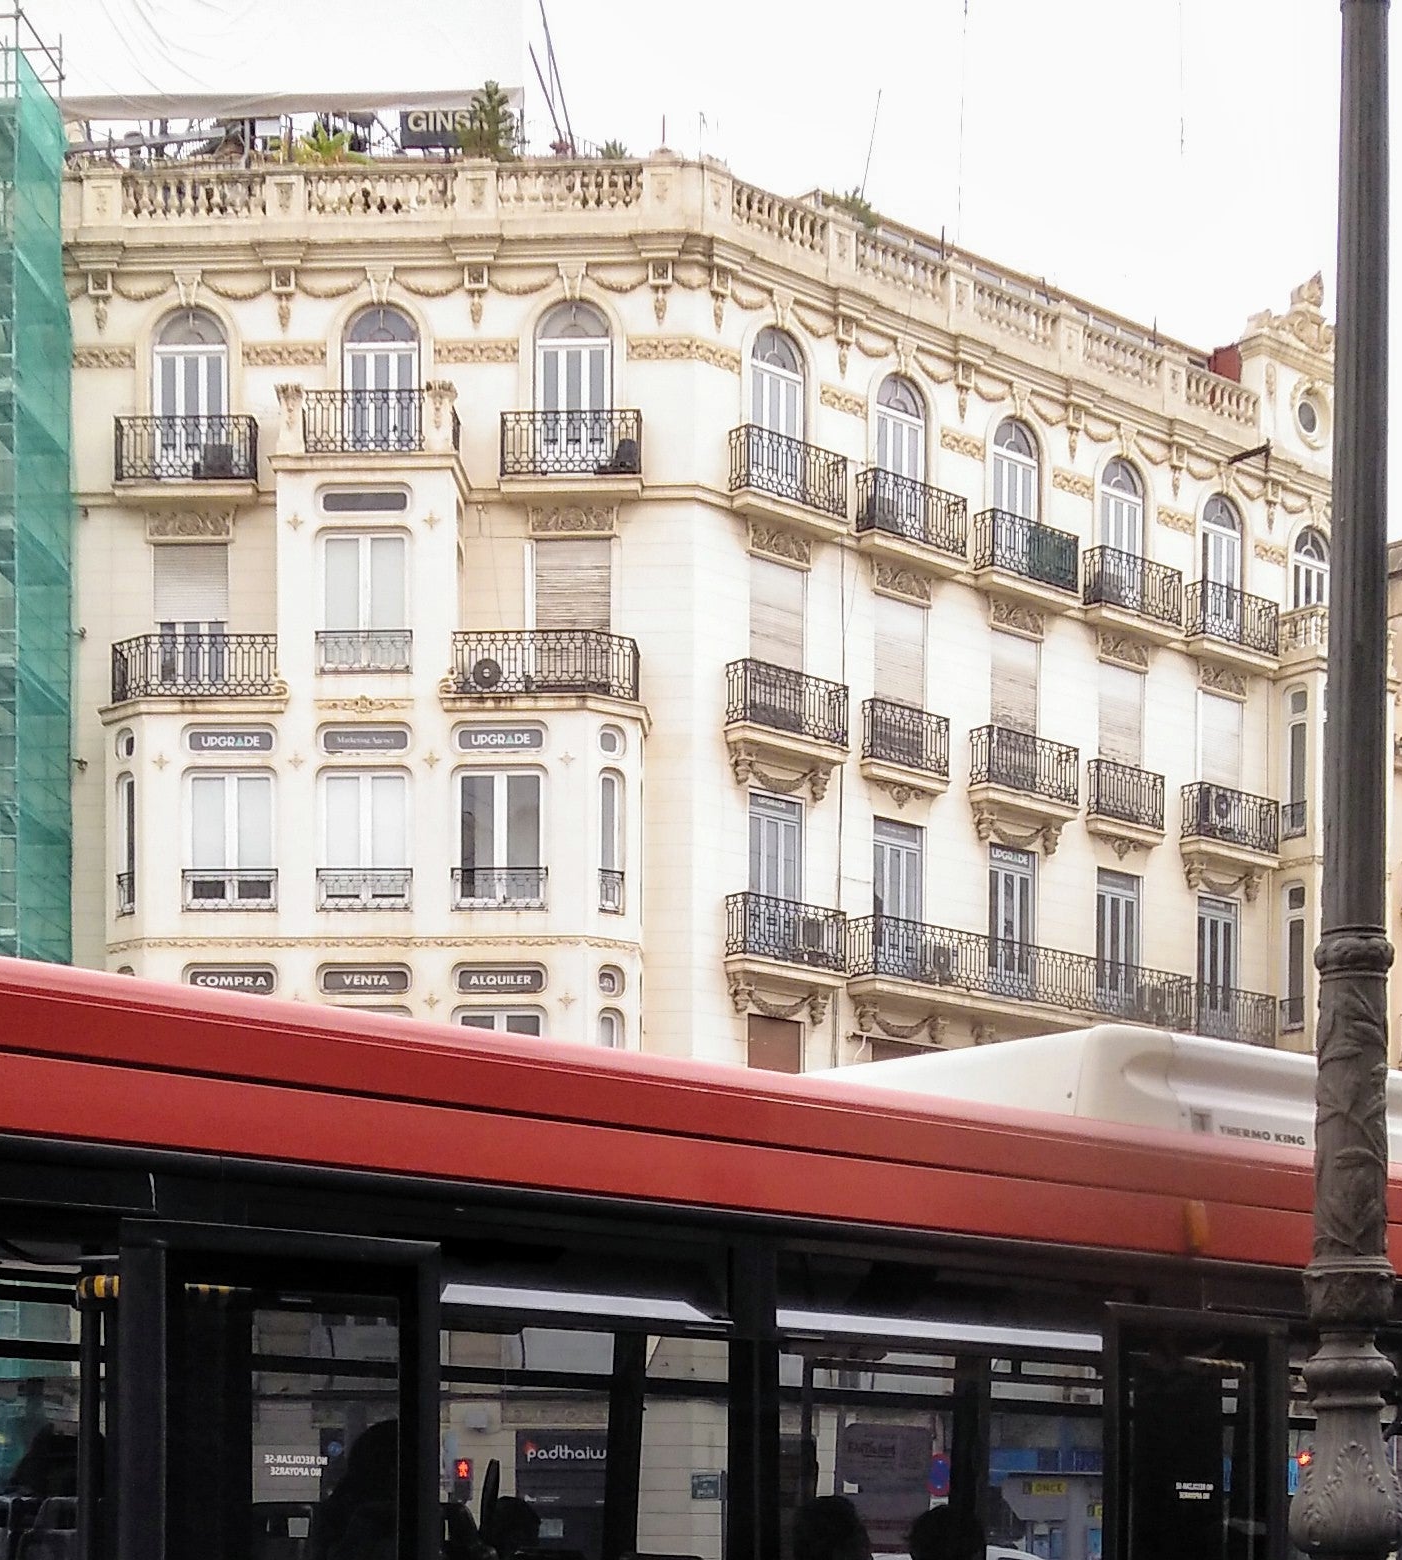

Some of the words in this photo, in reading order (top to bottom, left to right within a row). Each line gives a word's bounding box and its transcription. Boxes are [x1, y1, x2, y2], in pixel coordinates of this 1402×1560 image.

[201, 735, 261, 747] UPGRADE
[471, 733, 531, 746] UPGRADE
[991, 847, 1029, 866] UPGRADE
[197, 975, 268, 987] COMPRA
[341, 974, 390, 986] VENTA
[469, 974, 532, 986] ALQUILER
[1219, 1125, 1272, 1141] THERMO
[1274, 1132, 1306, 1146] KING
